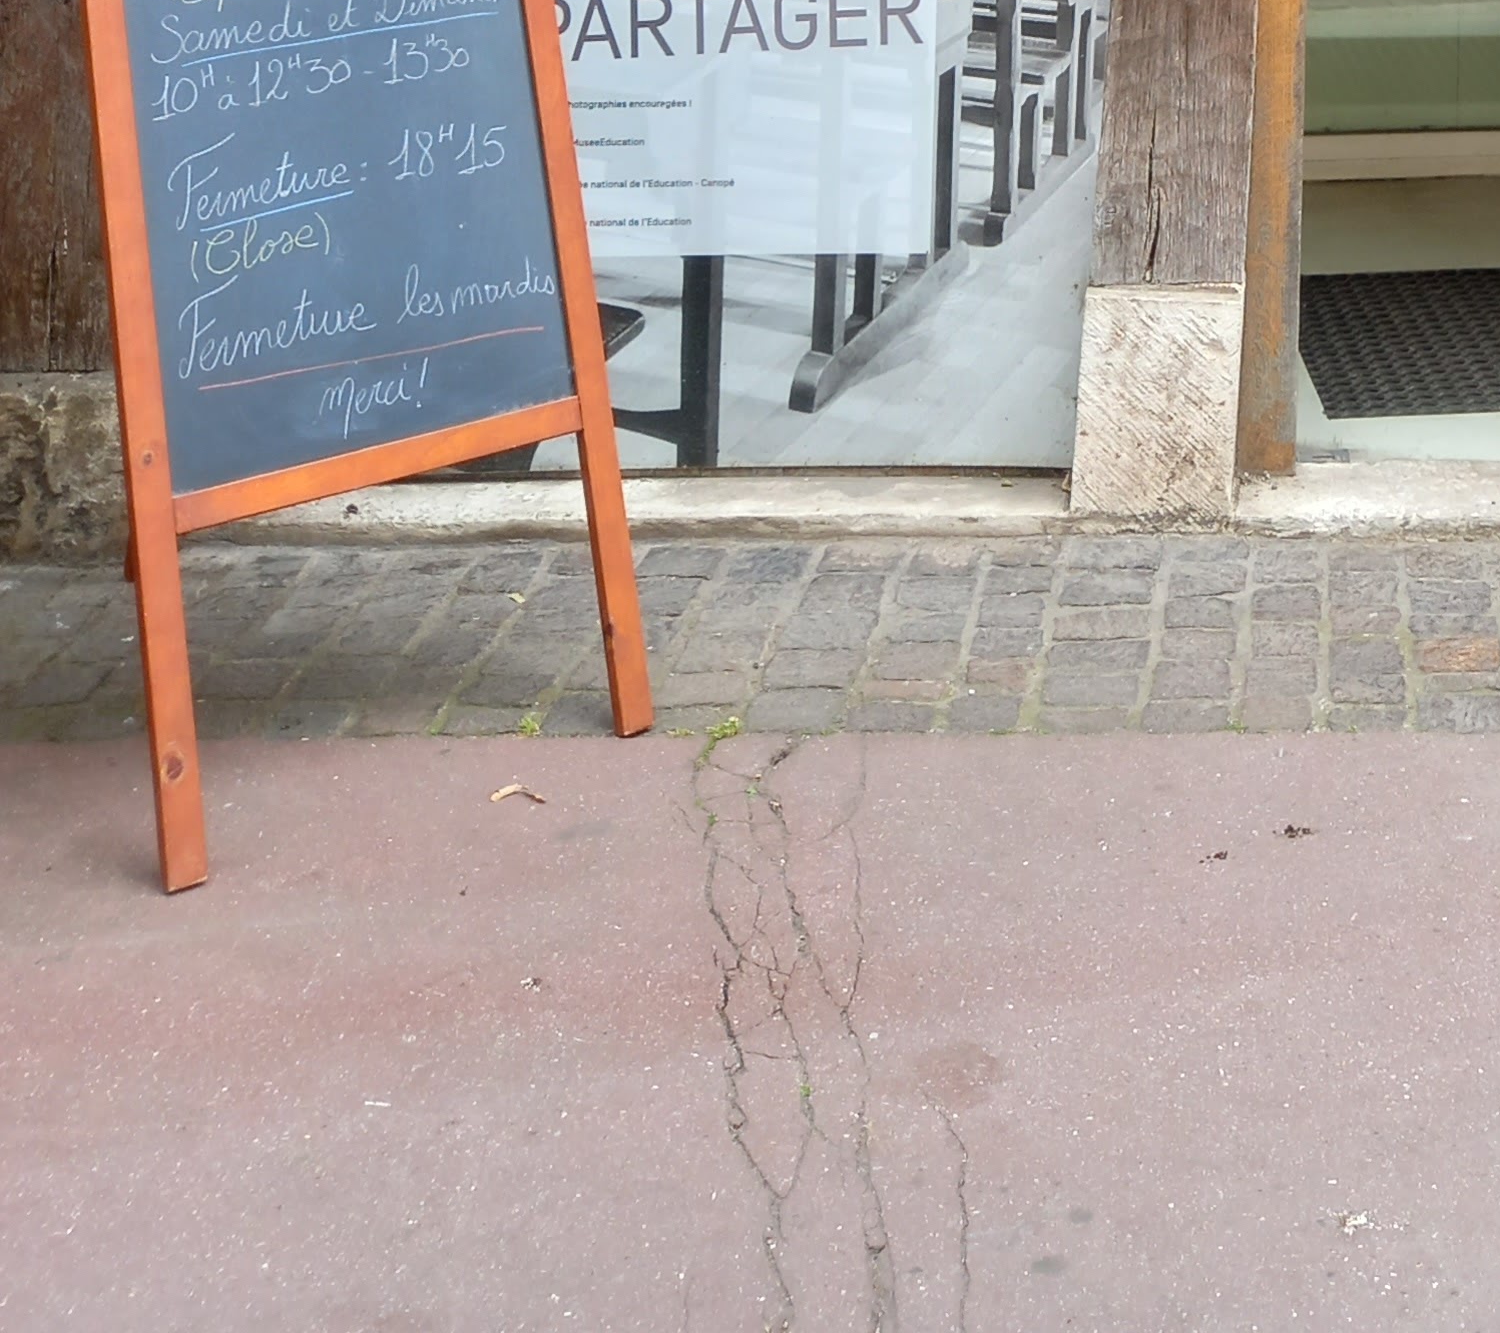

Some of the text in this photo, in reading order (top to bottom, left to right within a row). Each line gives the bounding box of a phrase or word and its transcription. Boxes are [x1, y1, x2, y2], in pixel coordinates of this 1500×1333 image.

[150, 0, 312, 64] Samedi
[590, 179, 628, 188] national
[629, 179, 641, 188] de
[191, 212, 330, 283] (Close)
[589, 218, 627, 227] national
[628, 218, 640, 227] de
[178, 274, 377, 379] Fermeture
[397, 263, 446, 325] les
